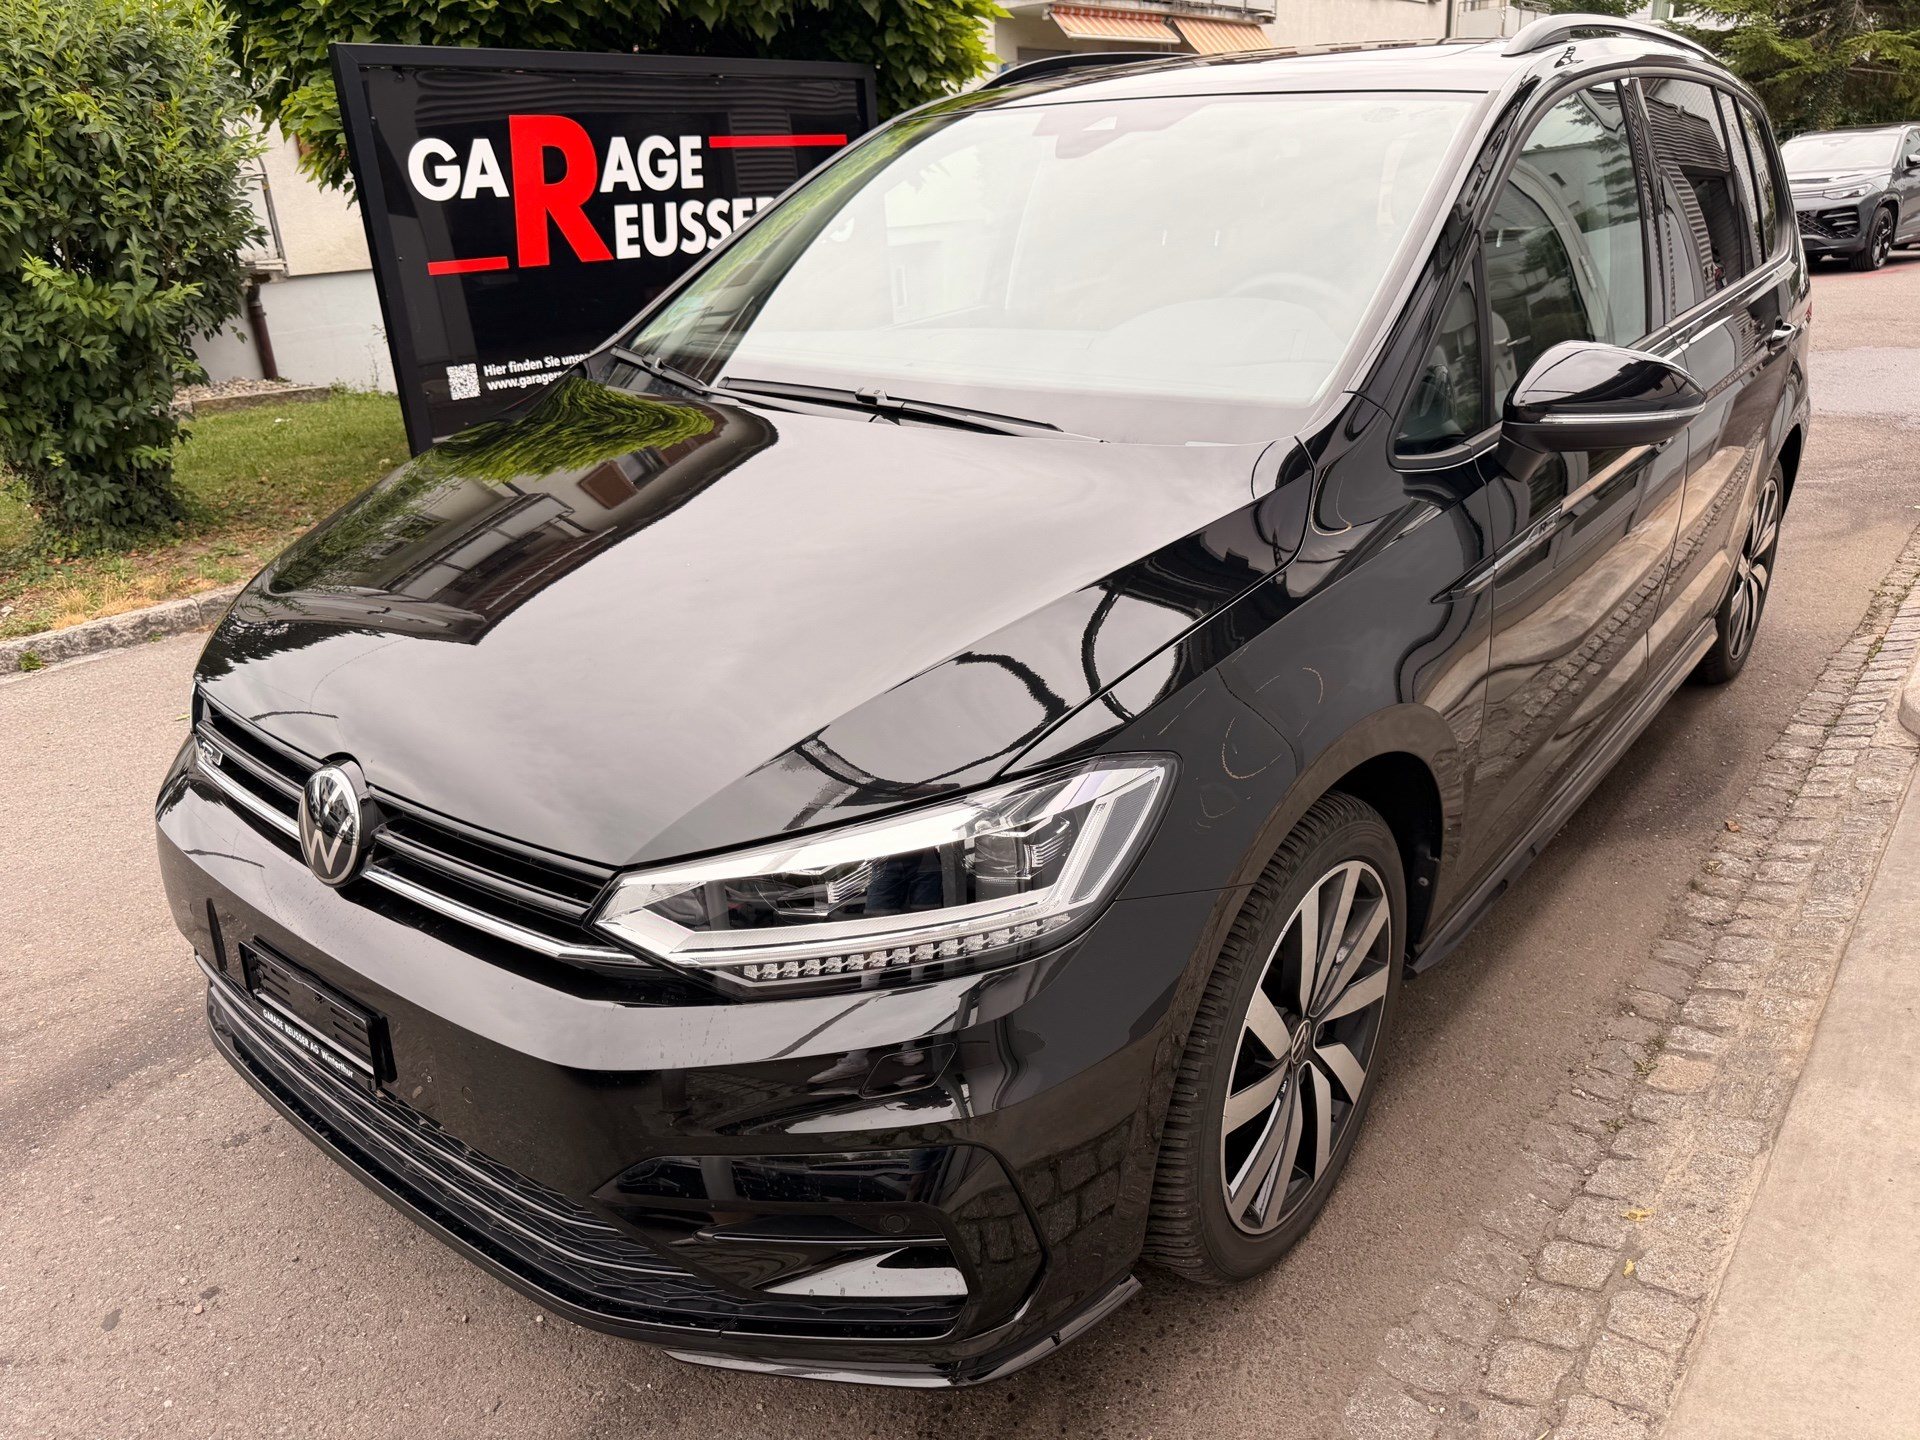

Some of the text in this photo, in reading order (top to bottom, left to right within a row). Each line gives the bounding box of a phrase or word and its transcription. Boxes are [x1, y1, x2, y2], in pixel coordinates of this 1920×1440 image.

[407, 114, 704, 268] GARAGE
[483, 364, 507, 377] Hier
[508, 359, 543, 373] finden
[544, 356, 561, 368] Sie
[262, 1009, 353, 1078] GARAGE REUSSER AG Winterthur
